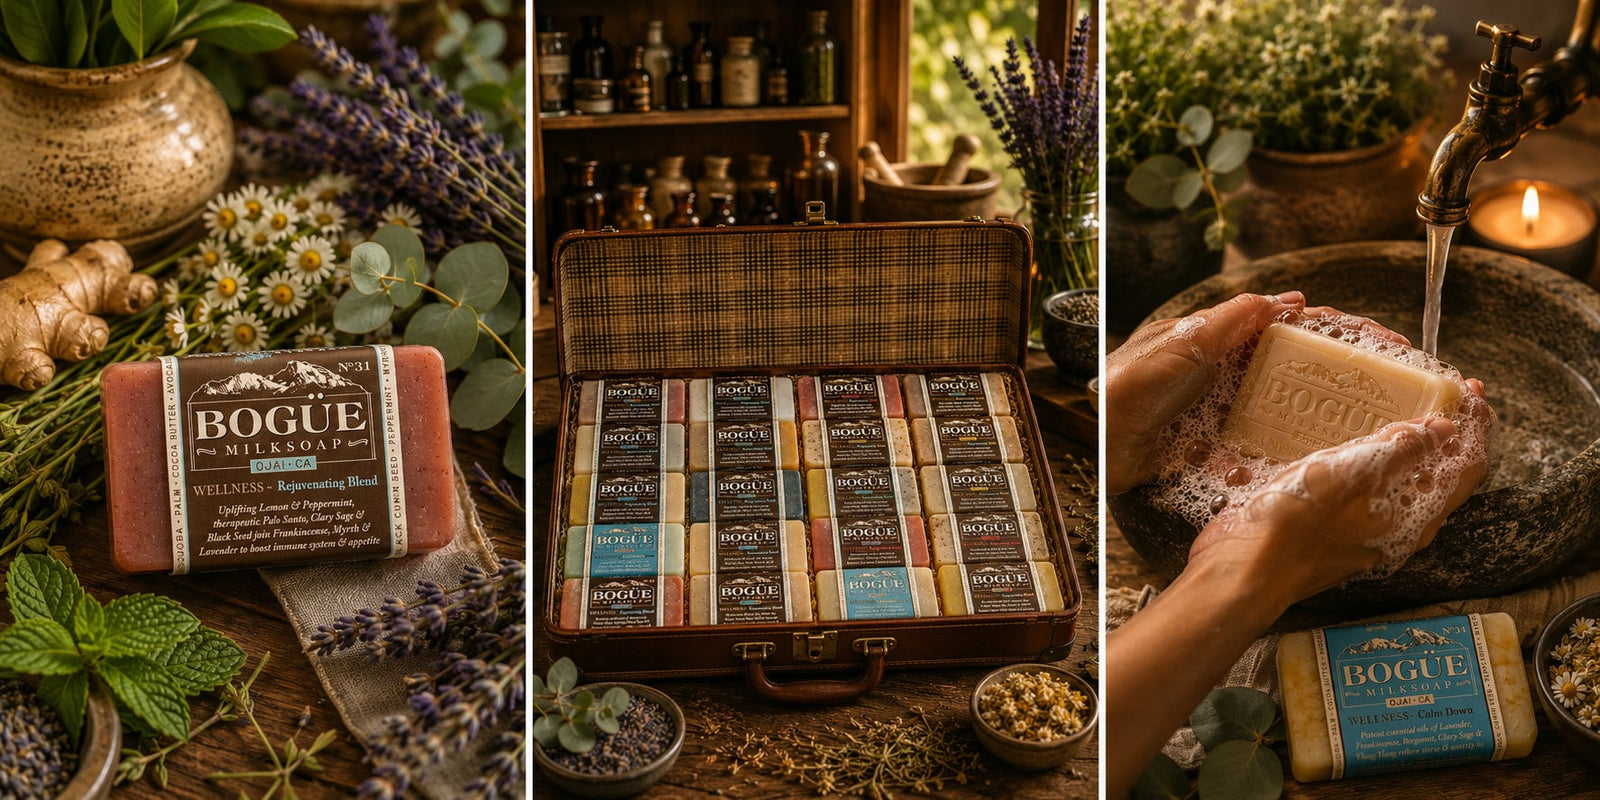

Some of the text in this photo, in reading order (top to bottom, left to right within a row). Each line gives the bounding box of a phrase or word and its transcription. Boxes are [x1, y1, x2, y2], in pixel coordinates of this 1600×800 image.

[167, 404, 178, 441] BUTTER
[195, 392, 367, 440] BOGÜE
[604, 431, 656, 442] BOGÜE
[225, 438, 342, 456] MILKSOAP
[170, 444, 180, 478] COCOA
[255, 459, 311, 472] OJAI CA
[390, 456, 399, 482] SEED
[837, 475, 888, 487] BOGÜE
[952, 472, 1004, 484] BOGÜE
[192, 481, 264, 496] WELLNESS
[278, 478, 345, 494] Rejuvenating
[347, 475, 378, 488] Blend
[601, 482, 655, 493] BOGÜE
[720, 480, 773, 491] BOGÜE
[218, 498, 355, 517] Uplifting Lemon & Peppermint,
[213, 510, 365, 530] therapeutic Palo Santo, Clary Sage &
[207, 522, 371, 542] Black Seed join Frankincense, Myrrh &
[843, 525, 897, 537] BOGÜE
[962, 521, 1015, 533] BOGÜE
[597, 532, 654, 544] BOGÜE
[721, 530, 775, 542] BOGÜE
[199, 536, 381, 556] Lavender to boost immune system & appetite
[972, 572, 1028, 585] BOGÜE
[593, 587, 652, 600] BOGÜE
[721, 584, 779, 596] BOGÜE
[1342, 650, 1468, 687] BOGÜE
[1366, 681, 1451, 697] MILKSOAP
[1389, 696, 1431, 706] OJAI CA
[1347, 707, 1473, 725] WELLNESS Calm Down
